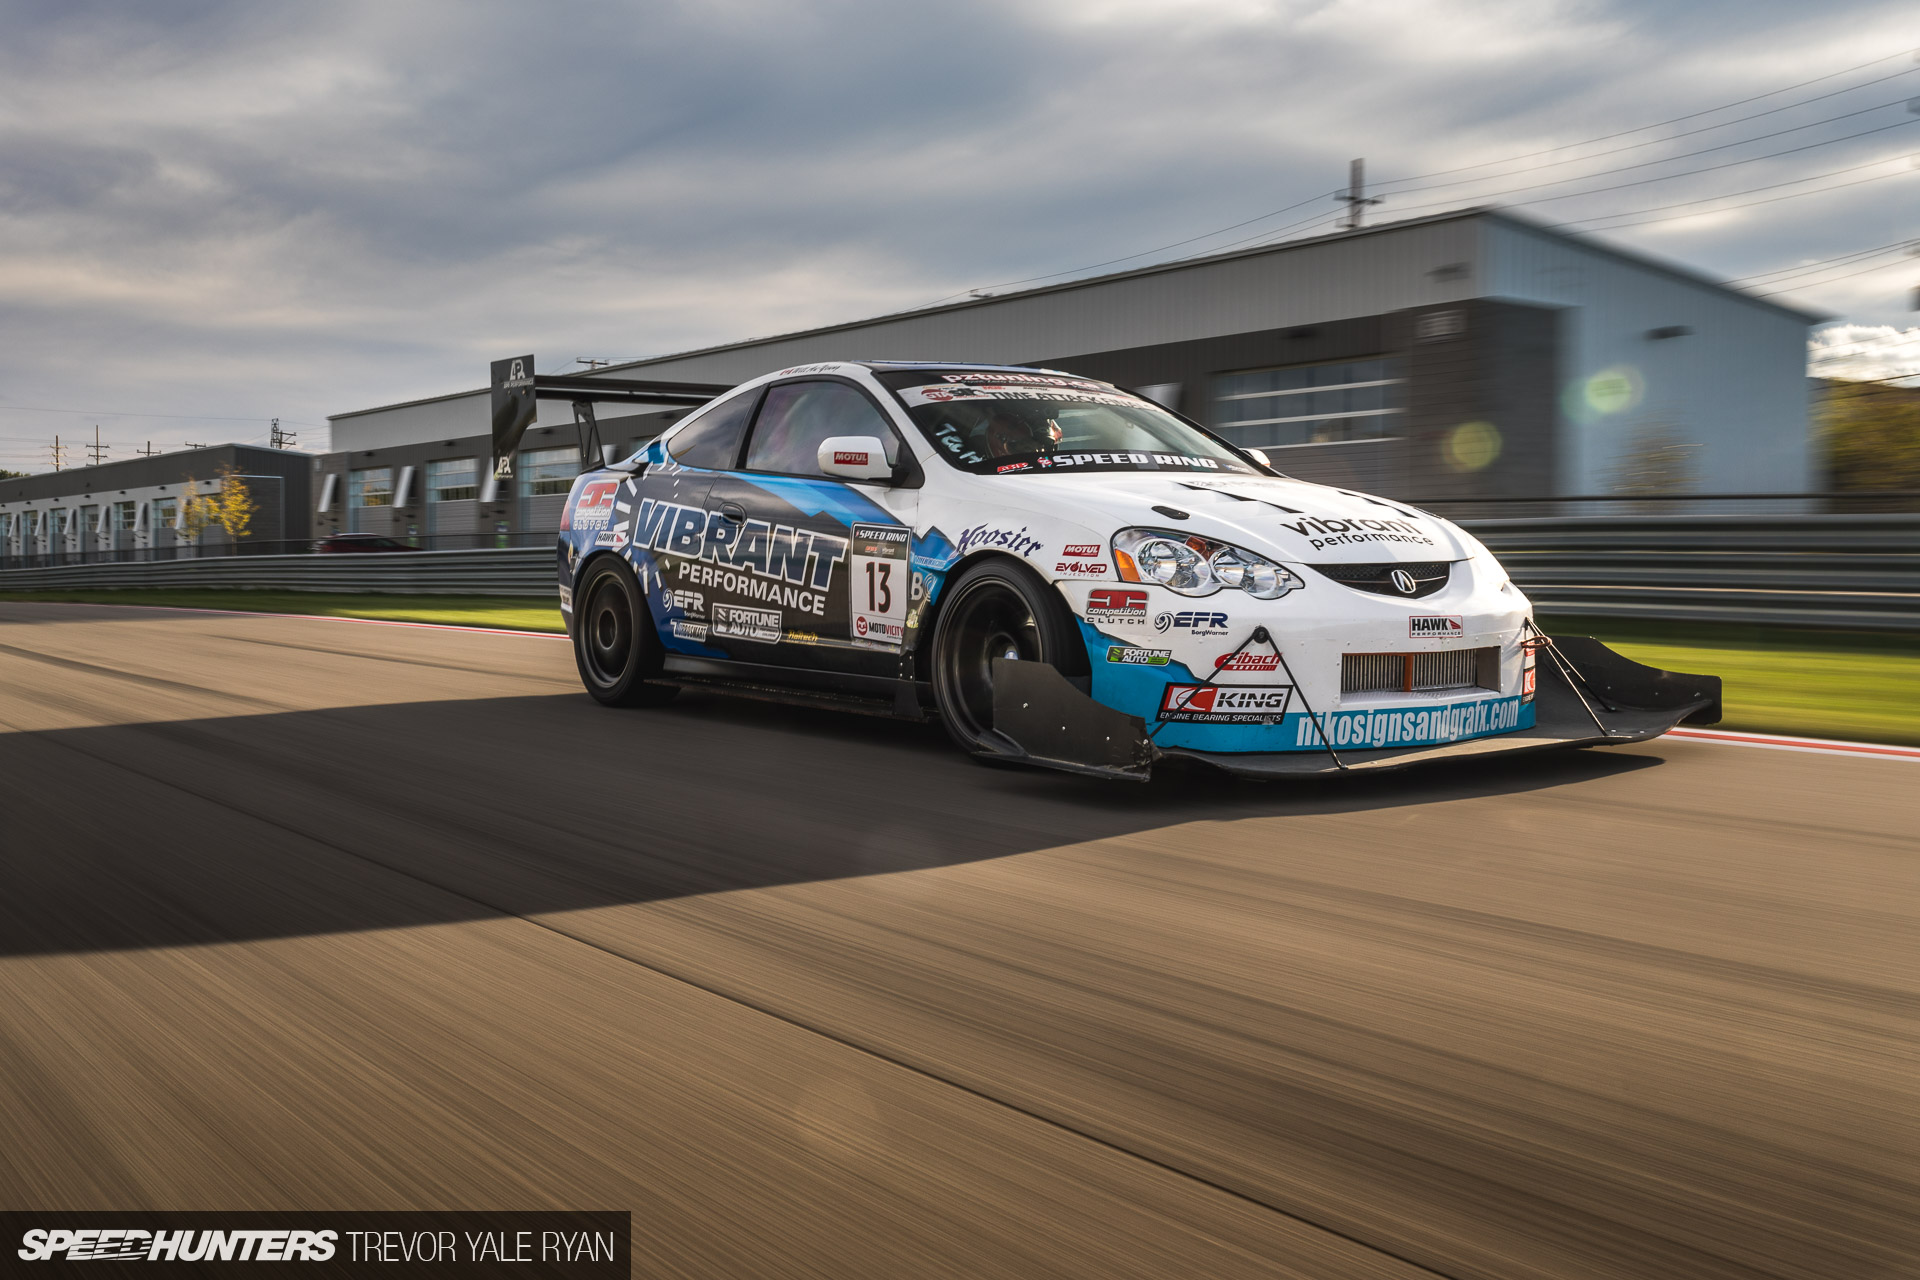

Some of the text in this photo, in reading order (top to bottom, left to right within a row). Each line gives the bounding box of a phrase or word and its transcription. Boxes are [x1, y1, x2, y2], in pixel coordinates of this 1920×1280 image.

[835, 453, 867, 461] MOTUL
[1053, 454, 1149, 467] SPEED
[1151, 455, 1219, 469] RING
[1280, 516, 1422, 536] vibrant
[597, 533, 616, 543] HAWK
[859, 529, 908, 543] SPEED RING
[954, 523, 1043, 558] Hoosier
[1309, 532, 1434, 550] performance
[632, 497, 849, 592] VIBRANT
[1055, 561, 1107, 573] EVOLVED
[678, 561, 826, 616] PERFORMANCE
[865, 561, 892, 614] 13
[673, 589, 704, 612] EFR
[729, 609, 779, 628] FORTUNE
[1087, 607, 1146, 618] competition
[1173, 611, 1229, 628] EFR
[1086, 617, 1145, 625] CLUTCH
[1412, 618, 1449, 631] HAWK
[728, 621, 758, 637] AUTO
[868, 621, 904, 637] MOTOVICITY
[1191, 629, 1229, 637] BorgWarner
[1121, 655, 1149, 664] AUTO
[1122, 648, 1171, 658] FORTUNE
[1217, 692, 1284, 708] KING
[1192, 713, 1230, 722] BEARING
[1232, 714, 1281, 722] SPECIALISTS
